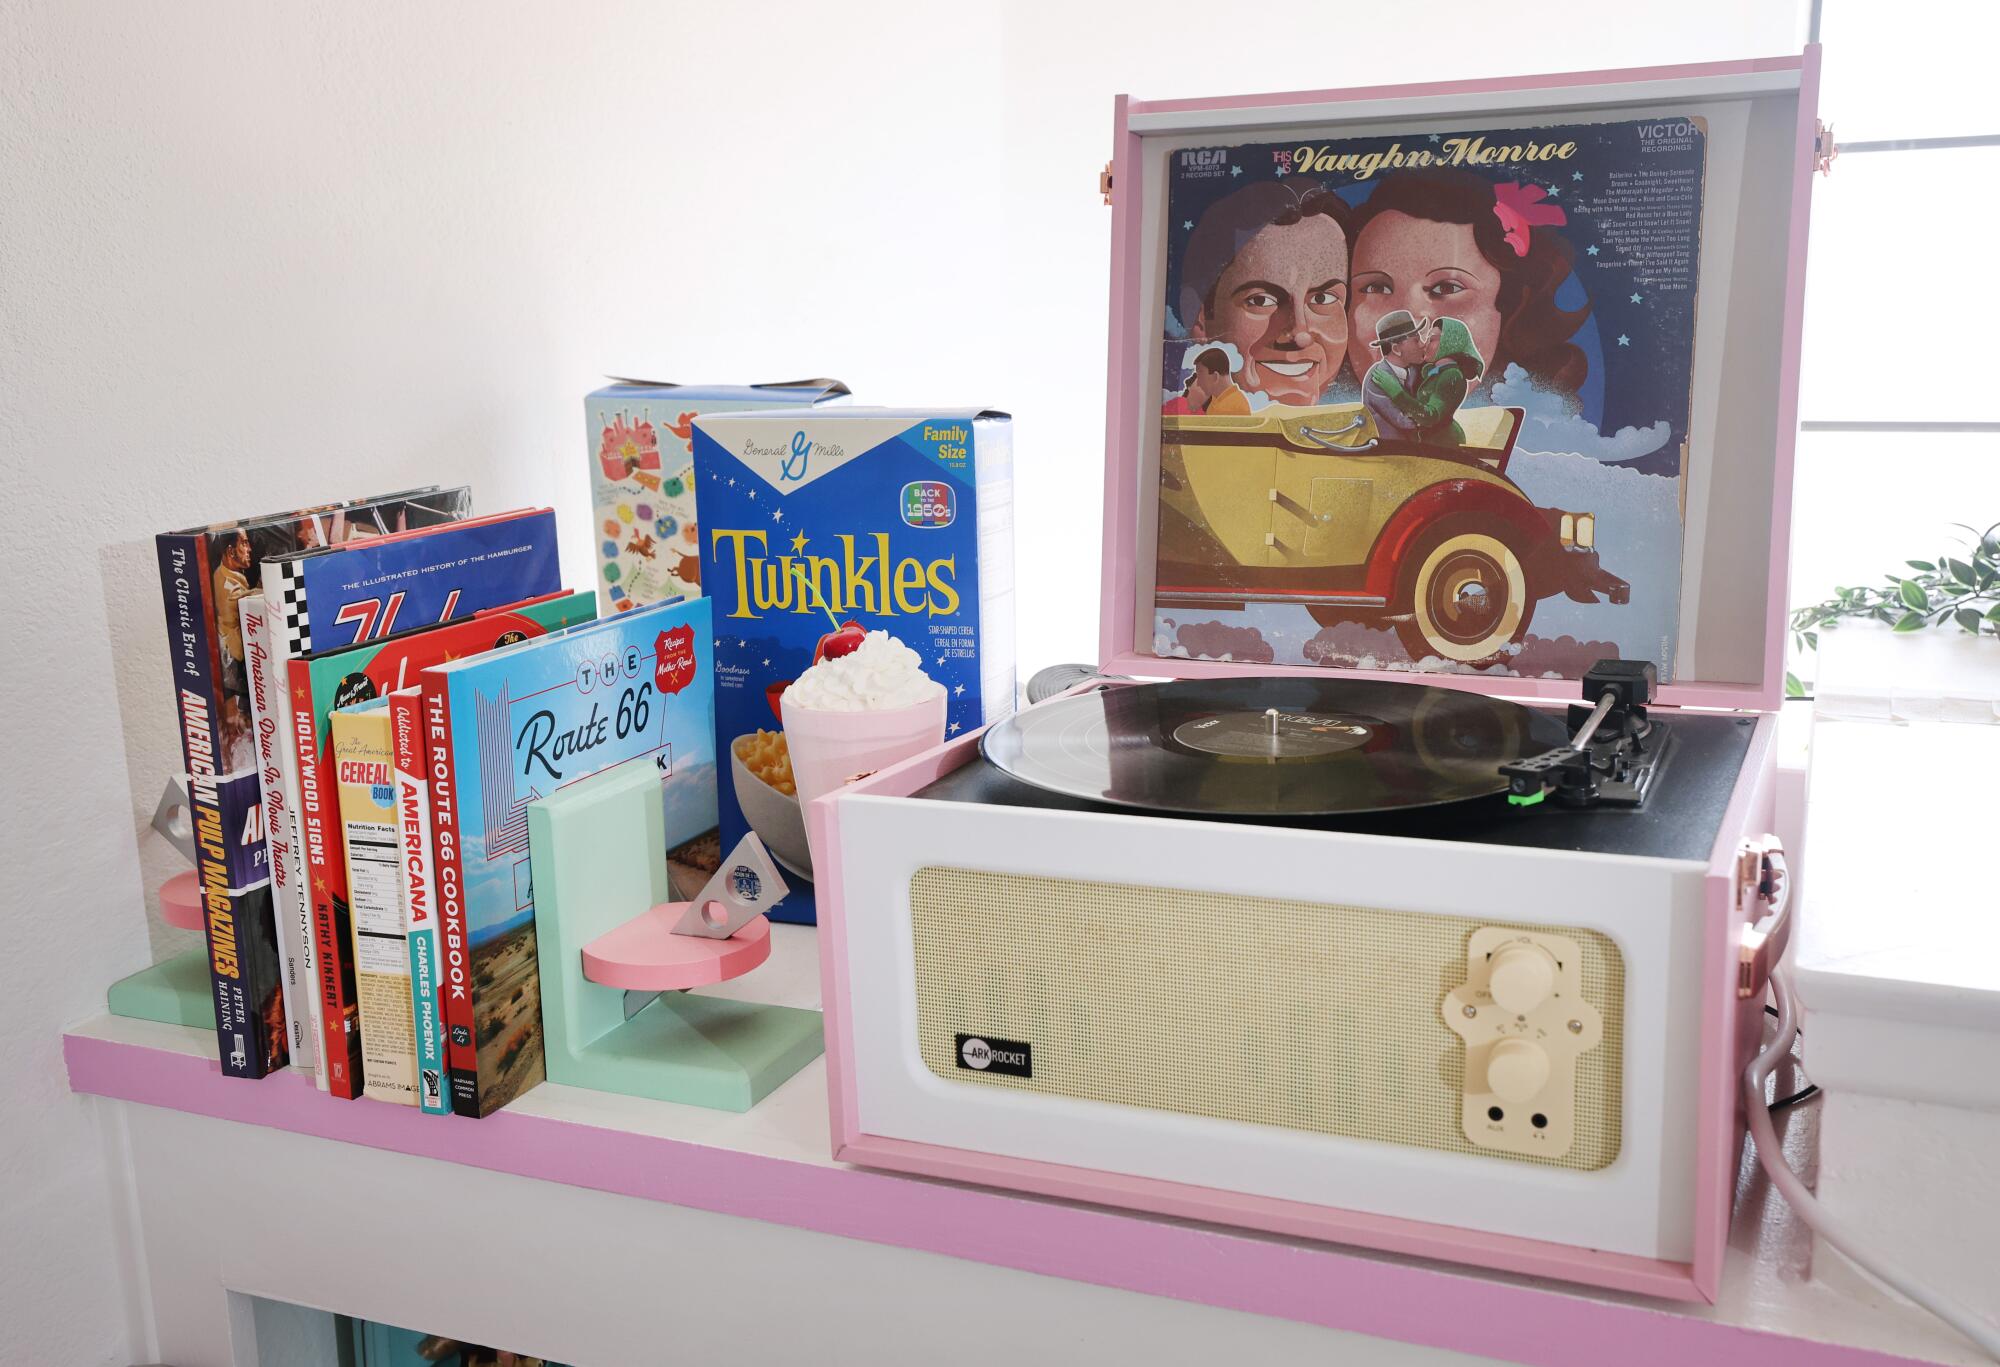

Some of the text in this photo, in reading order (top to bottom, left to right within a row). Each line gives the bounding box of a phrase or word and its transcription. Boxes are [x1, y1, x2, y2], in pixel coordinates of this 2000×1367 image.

[1637, 122, 1699, 139] VICTOR
[1641, 144, 1692, 153] RECORDINGS
[1657, 137, 1694, 145] ORIGINAL
[1181, 150, 1227, 166] RCA
[1272, 150, 1292, 163] THIS
[1293, 136, 1577, 180] Vaughn Monroe
[1186, 171, 1213, 179] RECORD
[1283, 162, 1291, 175] IS
[923, 425, 968, 444] Family
[743, 438, 787, 456] General
[812, 441, 844, 457] Mills
[938, 444, 966, 459] Size
[914, 488, 940, 497] BACK
[342, 544, 533, 591] THE ILLUSTRATED HISTORY OF THE HAMBURGER
[711, 528, 960, 619] Twinkles
[504, 632, 519, 645] The
[928, 625, 975, 635] STAR-SHAPED CEREAL
[663, 637, 685, 651] Recipes
[934, 638, 950, 648] CEREAL
[958, 639, 975, 648] FORMA
[944, 648, 975, 658] DE ESTRELLAS
[581, 653, 637, 686] THE
[656, 654, 693, 676] Mother Road
[715, 659, 750, 675] Goodness
[516, 681, 653, 779] Route 66
[246, 612, 289, 889] The American Drive-In Movie Theatre
[335, 741, 394, 759] Great American
[171, 548, 240, 980] The Classic Era of AMERICAN PULP MAGAZINES
[341, 761, 390, 786] CEREAL
[296, 711, 325, 866] HOLLYWOOD SIGNS
[372, 786, 394, 801] BOOK
[396, 706, 427, 923] Addicted to AMERICANA
[347, 823, 375, 831] Nutrition
[429, 694, 465, 1000] THE ROUTE 66 COOKBOOK
[289, 805, 311, 969] JEFFREY TENNYSON
[317, 903, 337, 1009] KATHY KIKKERT
[288, 957, 297, 986] Sanders
[218, 980, 233, 1031] HAINING
[233, 986, 245, 1024] PETER
[416, 936, 435, 1060] CHARLES PHOENIX
[453, 1027, 468, 1036] Linda
[972, 1047, 1026, 1066] ARK ROCKET
[367, 1080, 396, 1090] ABRAMS
[454, 1078, 475, 1086] HARVARD
[454, 1085, 475, 1093] COMMON
